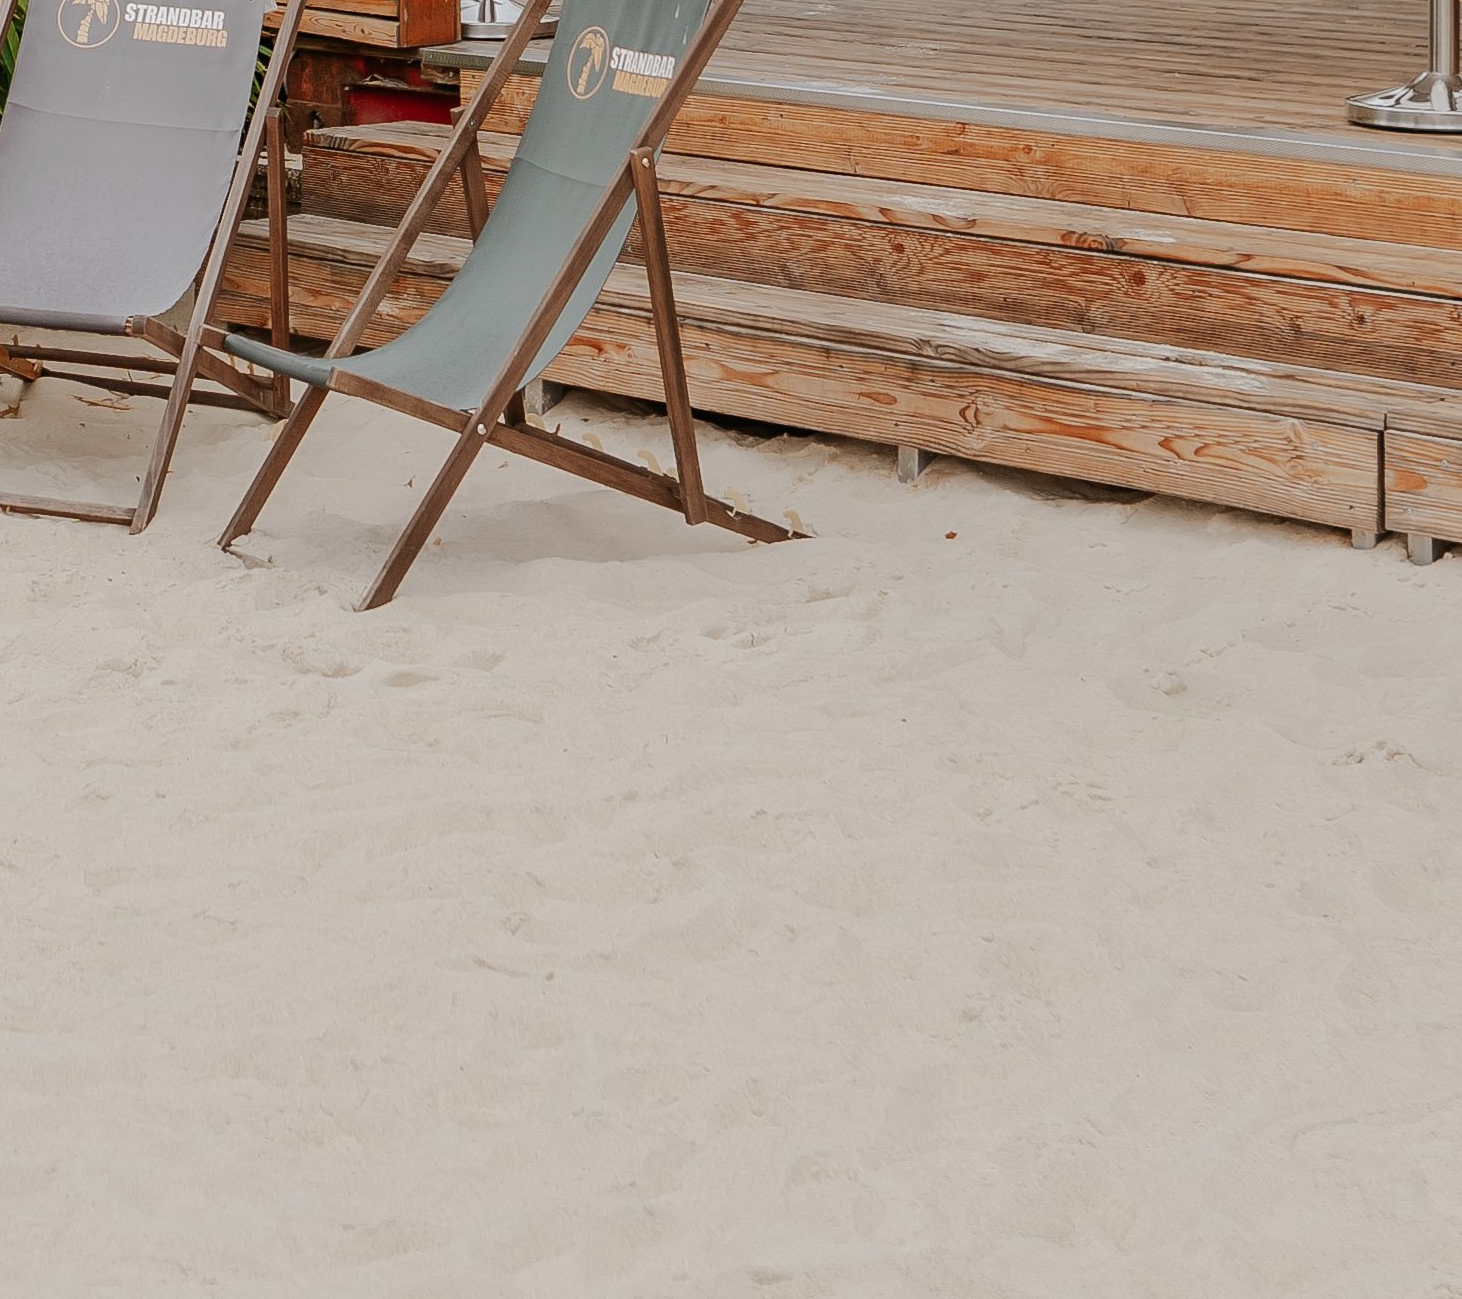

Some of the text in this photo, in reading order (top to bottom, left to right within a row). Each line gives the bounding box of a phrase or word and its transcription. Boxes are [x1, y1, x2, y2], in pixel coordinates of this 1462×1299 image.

[124, 2, 225, 30] STRANDBAR
[133, 22, 228, 48] MAGDEBURG
[610, 46, 676, 80] STRANDBAR
